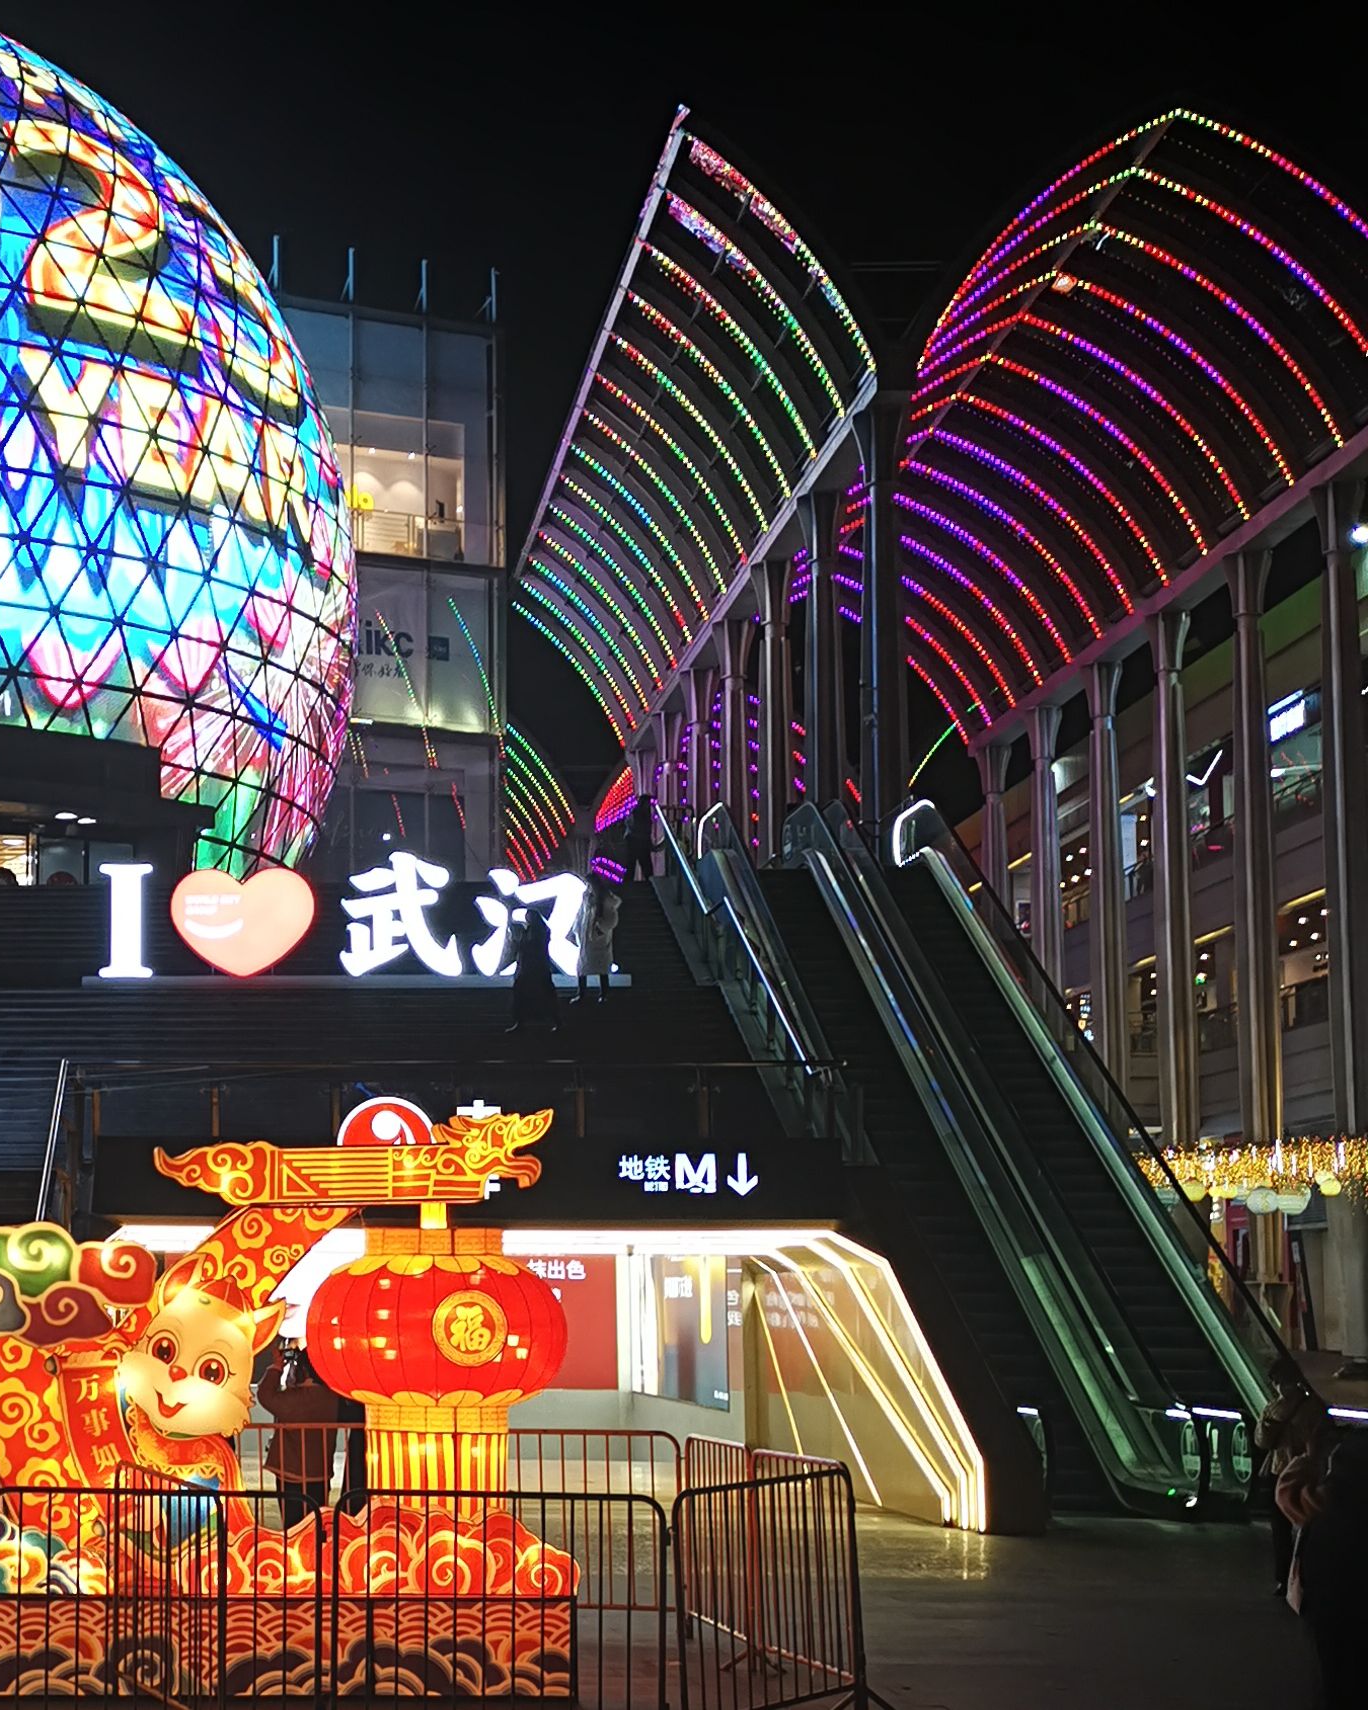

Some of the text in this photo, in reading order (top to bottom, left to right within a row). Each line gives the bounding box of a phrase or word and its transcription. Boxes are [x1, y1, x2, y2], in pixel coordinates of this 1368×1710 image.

[18, 345, 314, 545] YEAR
[98, 863, 154, 978] I
[619, 1154, 671, 1181] 地铁
[450, 1304, 492, 1352] 福
